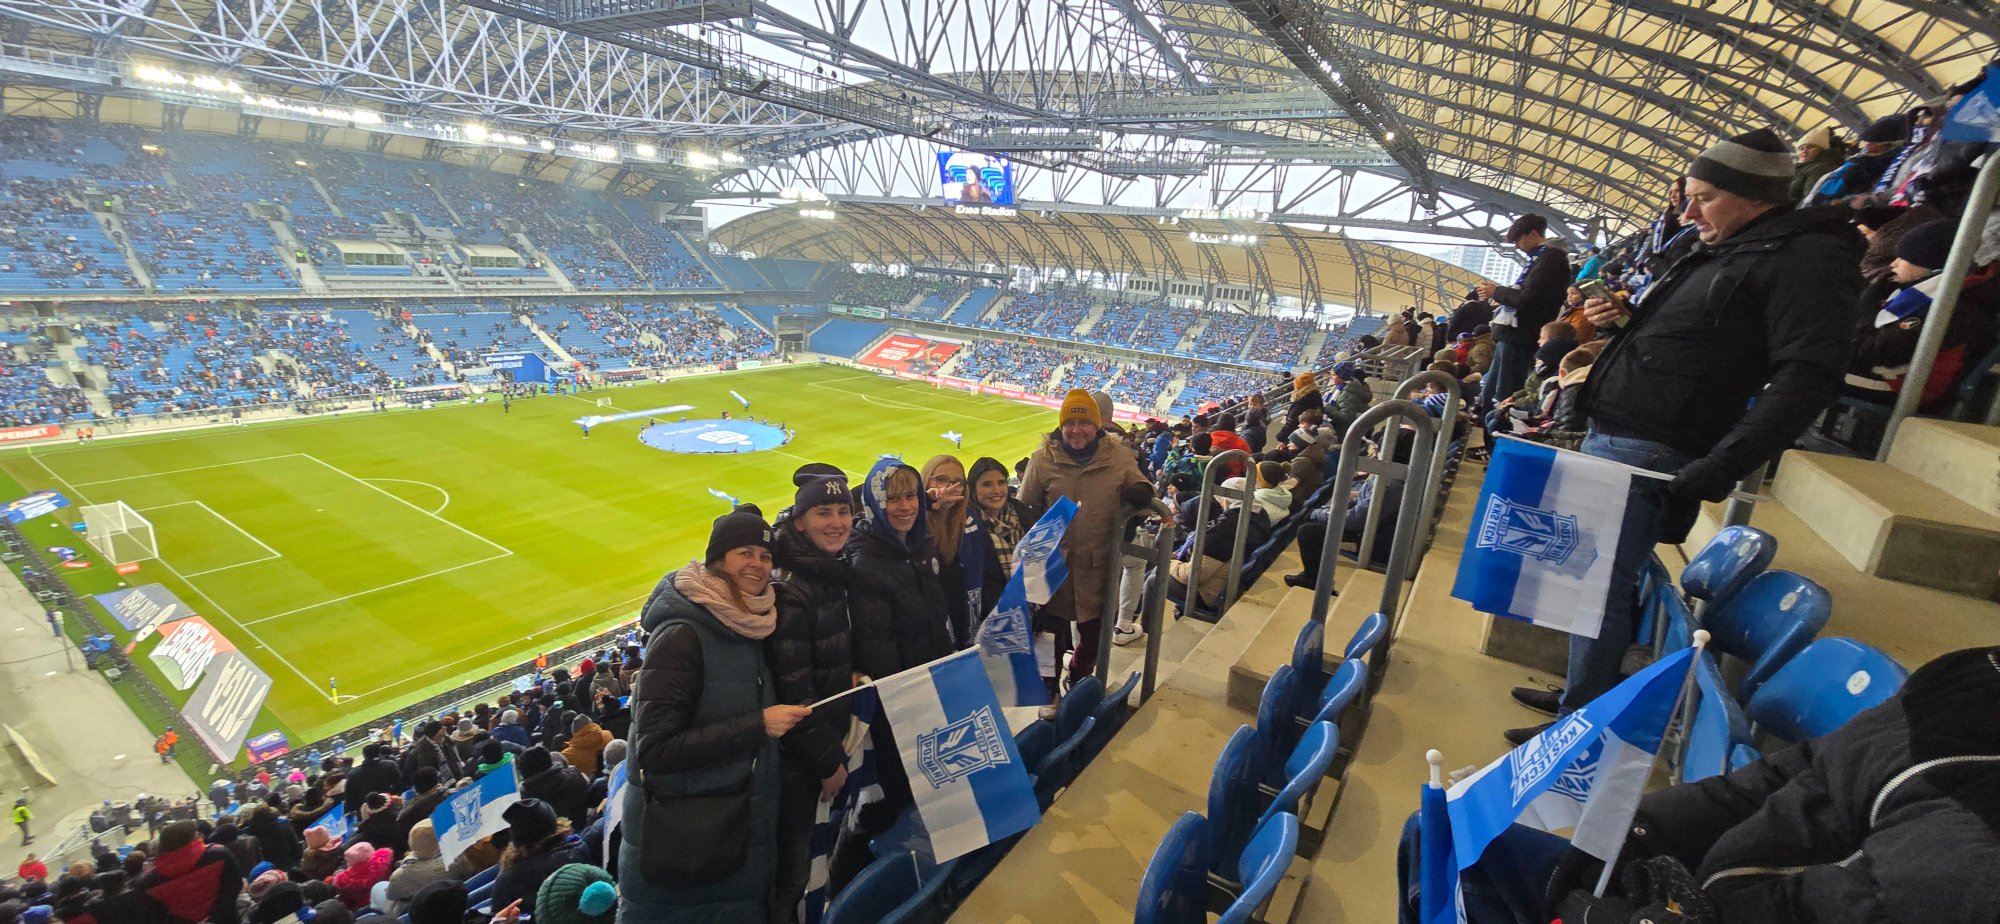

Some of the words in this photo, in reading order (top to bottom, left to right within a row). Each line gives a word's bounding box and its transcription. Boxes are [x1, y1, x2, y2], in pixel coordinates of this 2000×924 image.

[955, 204, 980, 215] Enea
[981, 205, 1017, 217] Stadion
[825, 481, 842, 495] NY
[148, 621, 217, 690] SUPERBET
[980, 715, 994, 734] KKS
[987, 734, 1002, 758] LECH
